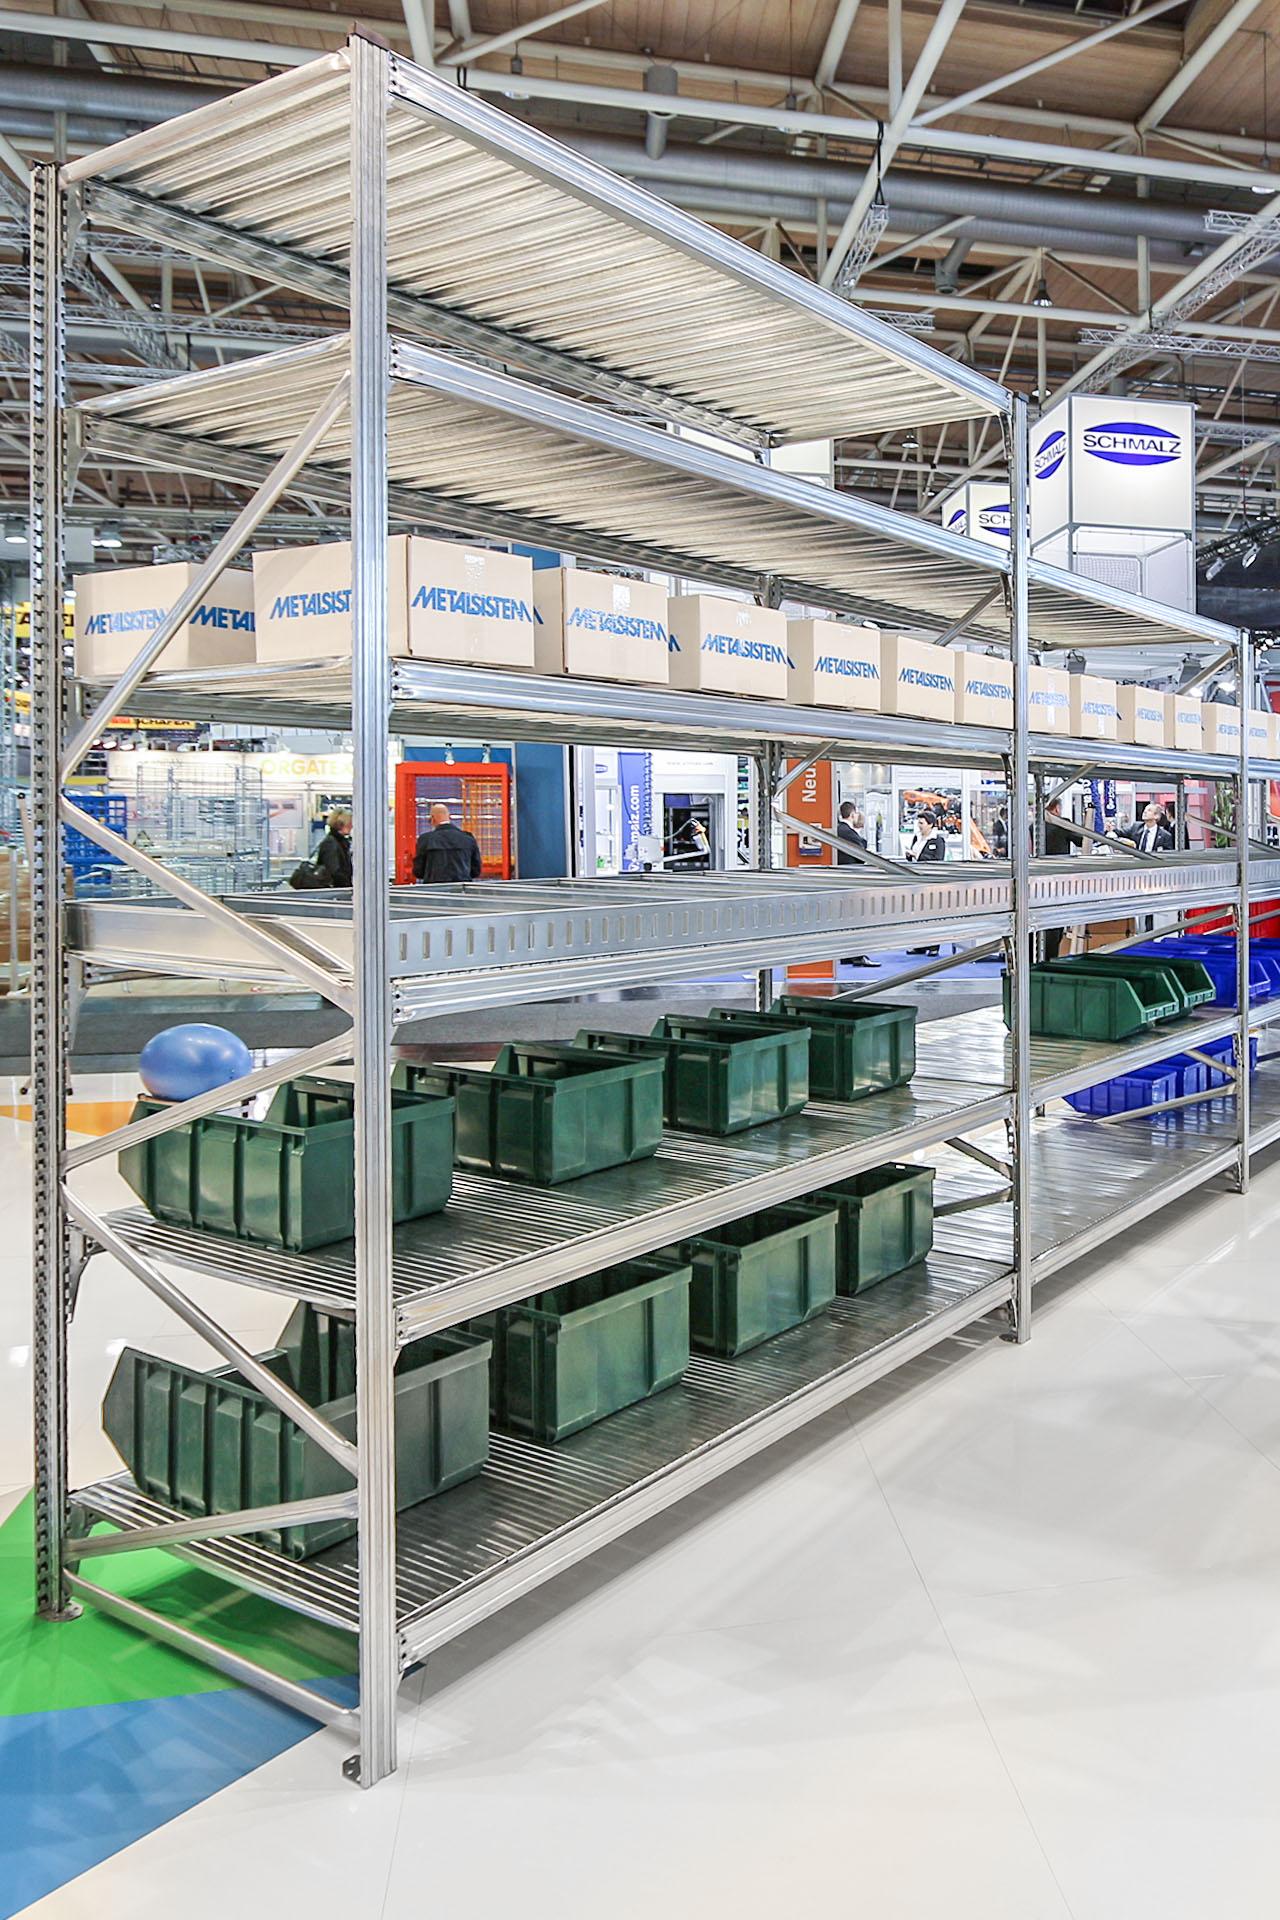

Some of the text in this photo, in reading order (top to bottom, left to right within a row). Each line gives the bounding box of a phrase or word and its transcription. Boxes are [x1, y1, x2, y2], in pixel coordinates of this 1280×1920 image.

[1034, 437, 1067, 472] SCHMALZ
[1083, 434, 1182, 455] SCHMALZ
[411, 585, 543, 625] METALSISTEM
[566, 607, 680, 652] METALSISTEM
[701, 633, 795, 669] METALSISTEM
[813, 655, 880, 680] METALSISTEM
[897, 667, 955, 692] METALSISTEM
